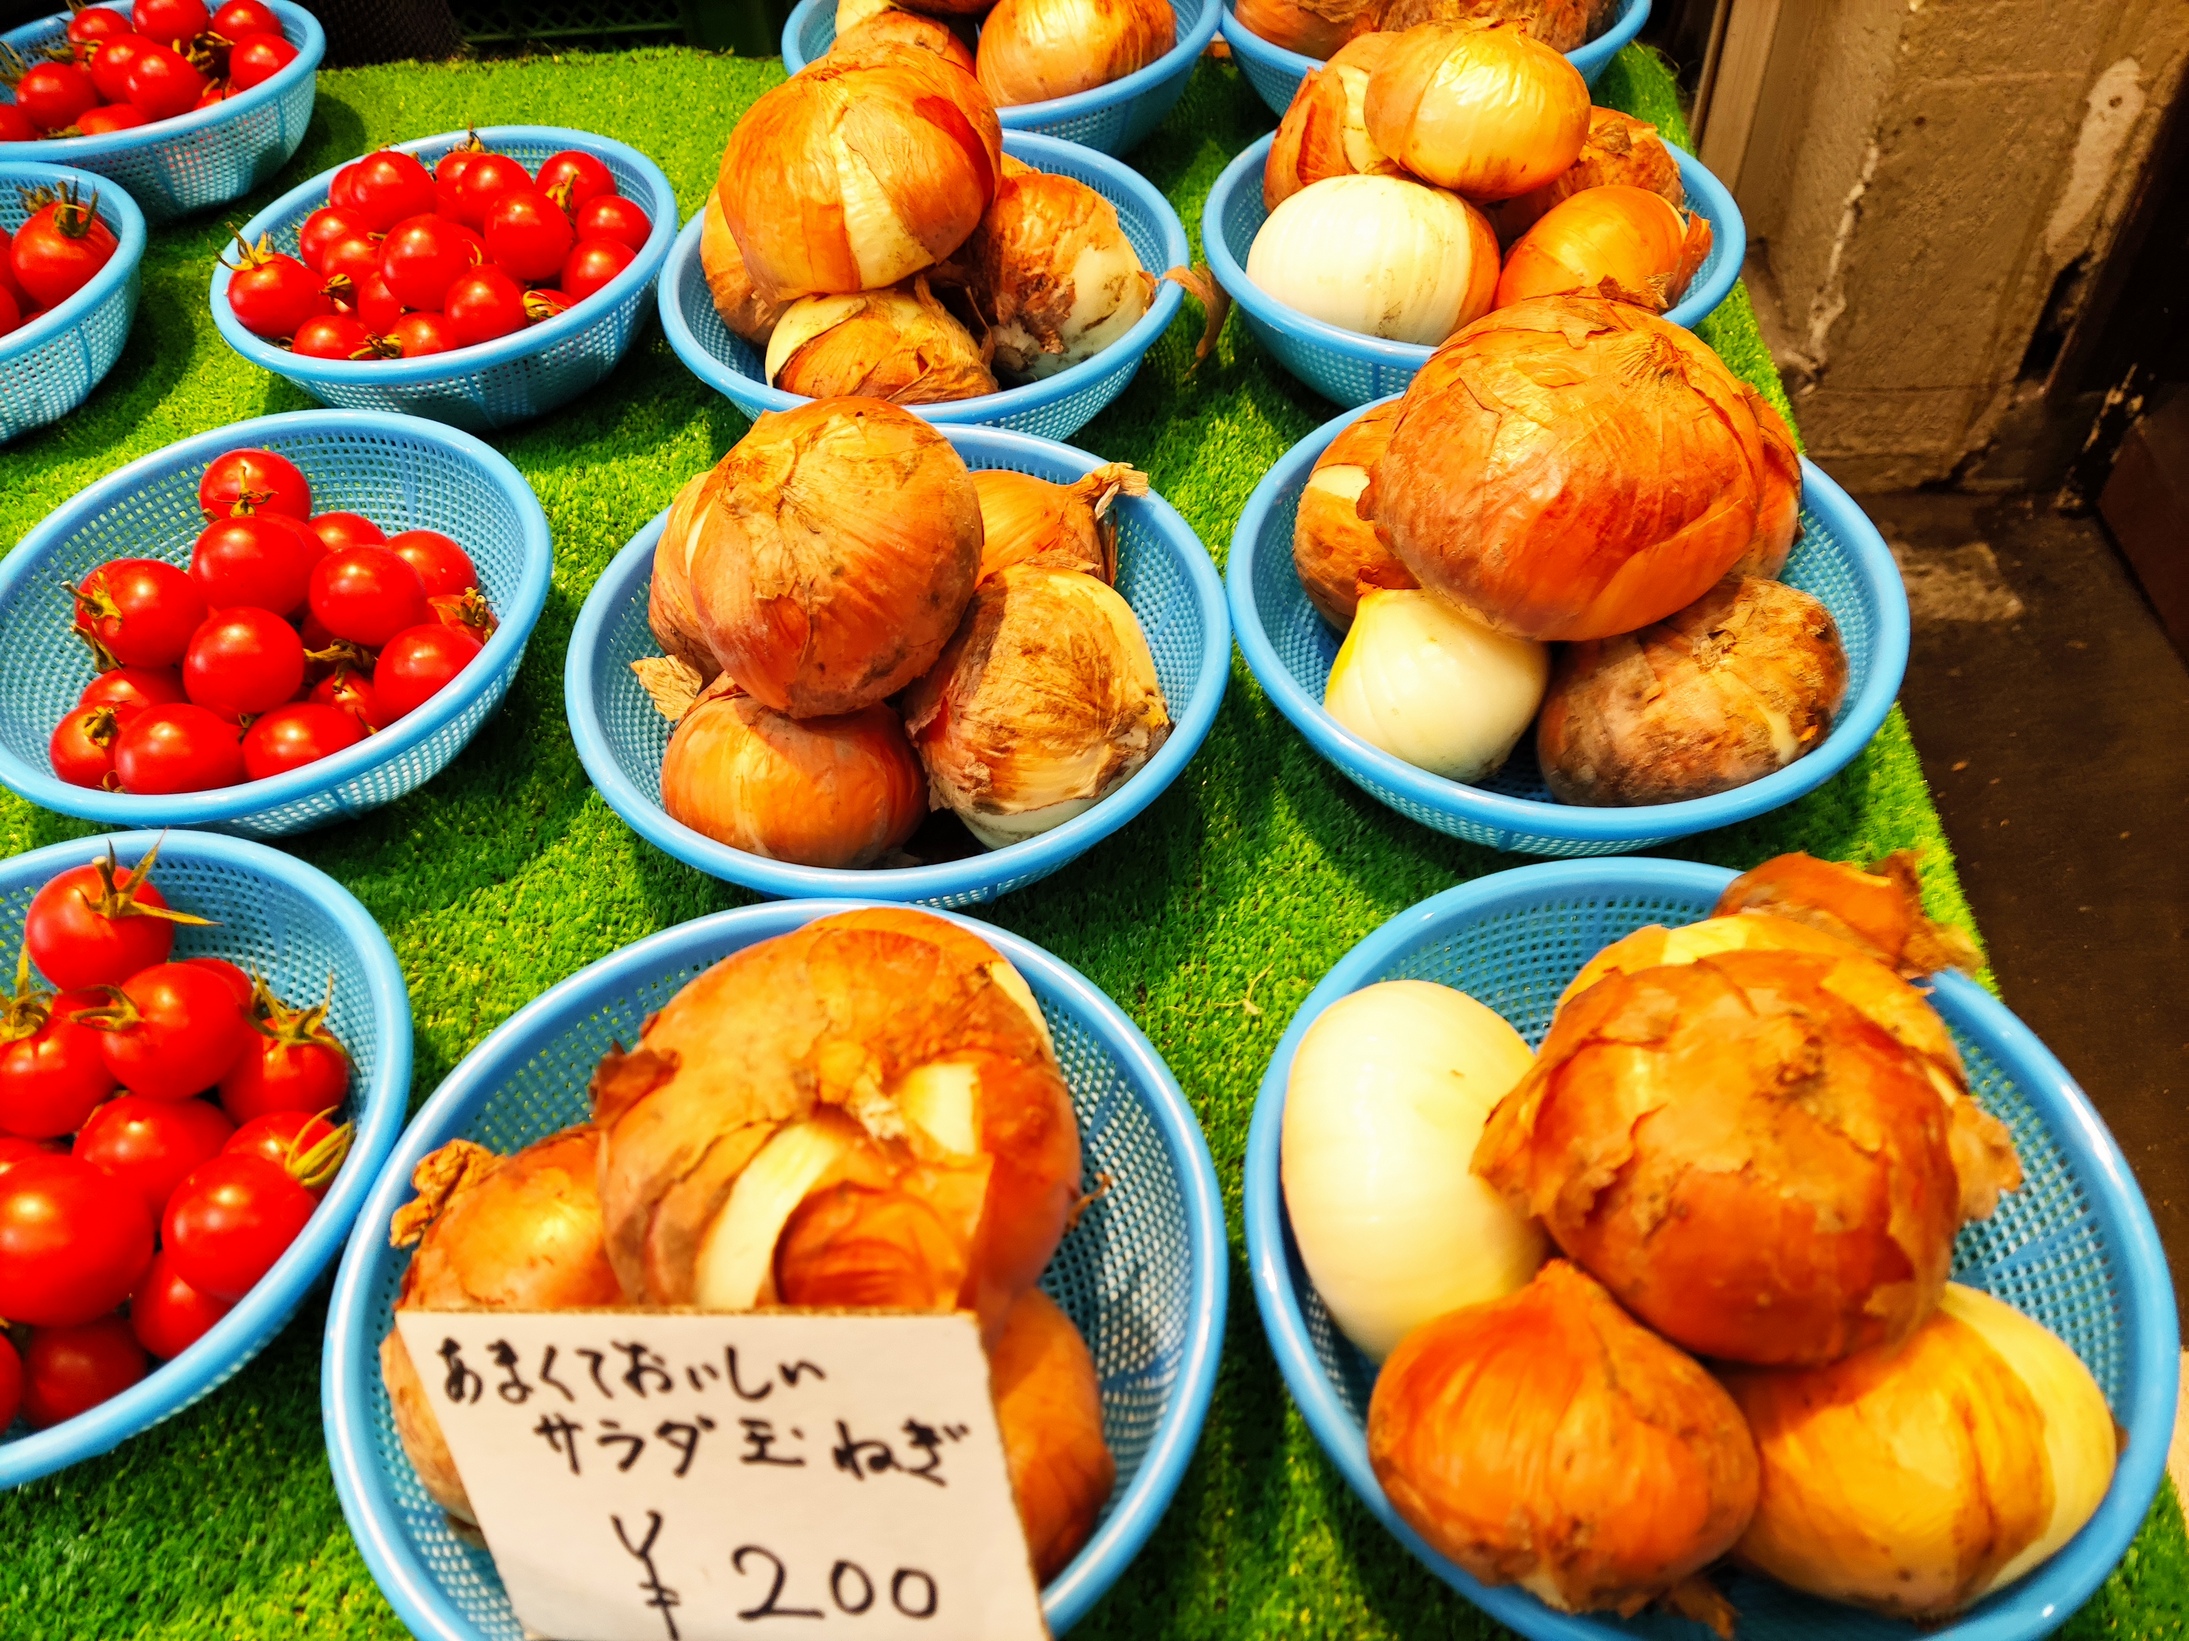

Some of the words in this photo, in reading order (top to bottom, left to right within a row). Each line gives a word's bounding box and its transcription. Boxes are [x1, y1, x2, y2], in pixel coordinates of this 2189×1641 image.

[437, 1334, 826, 1406] あまくておいしい
[532, 1413, 973, 1488] サラダ玉ねぎ
